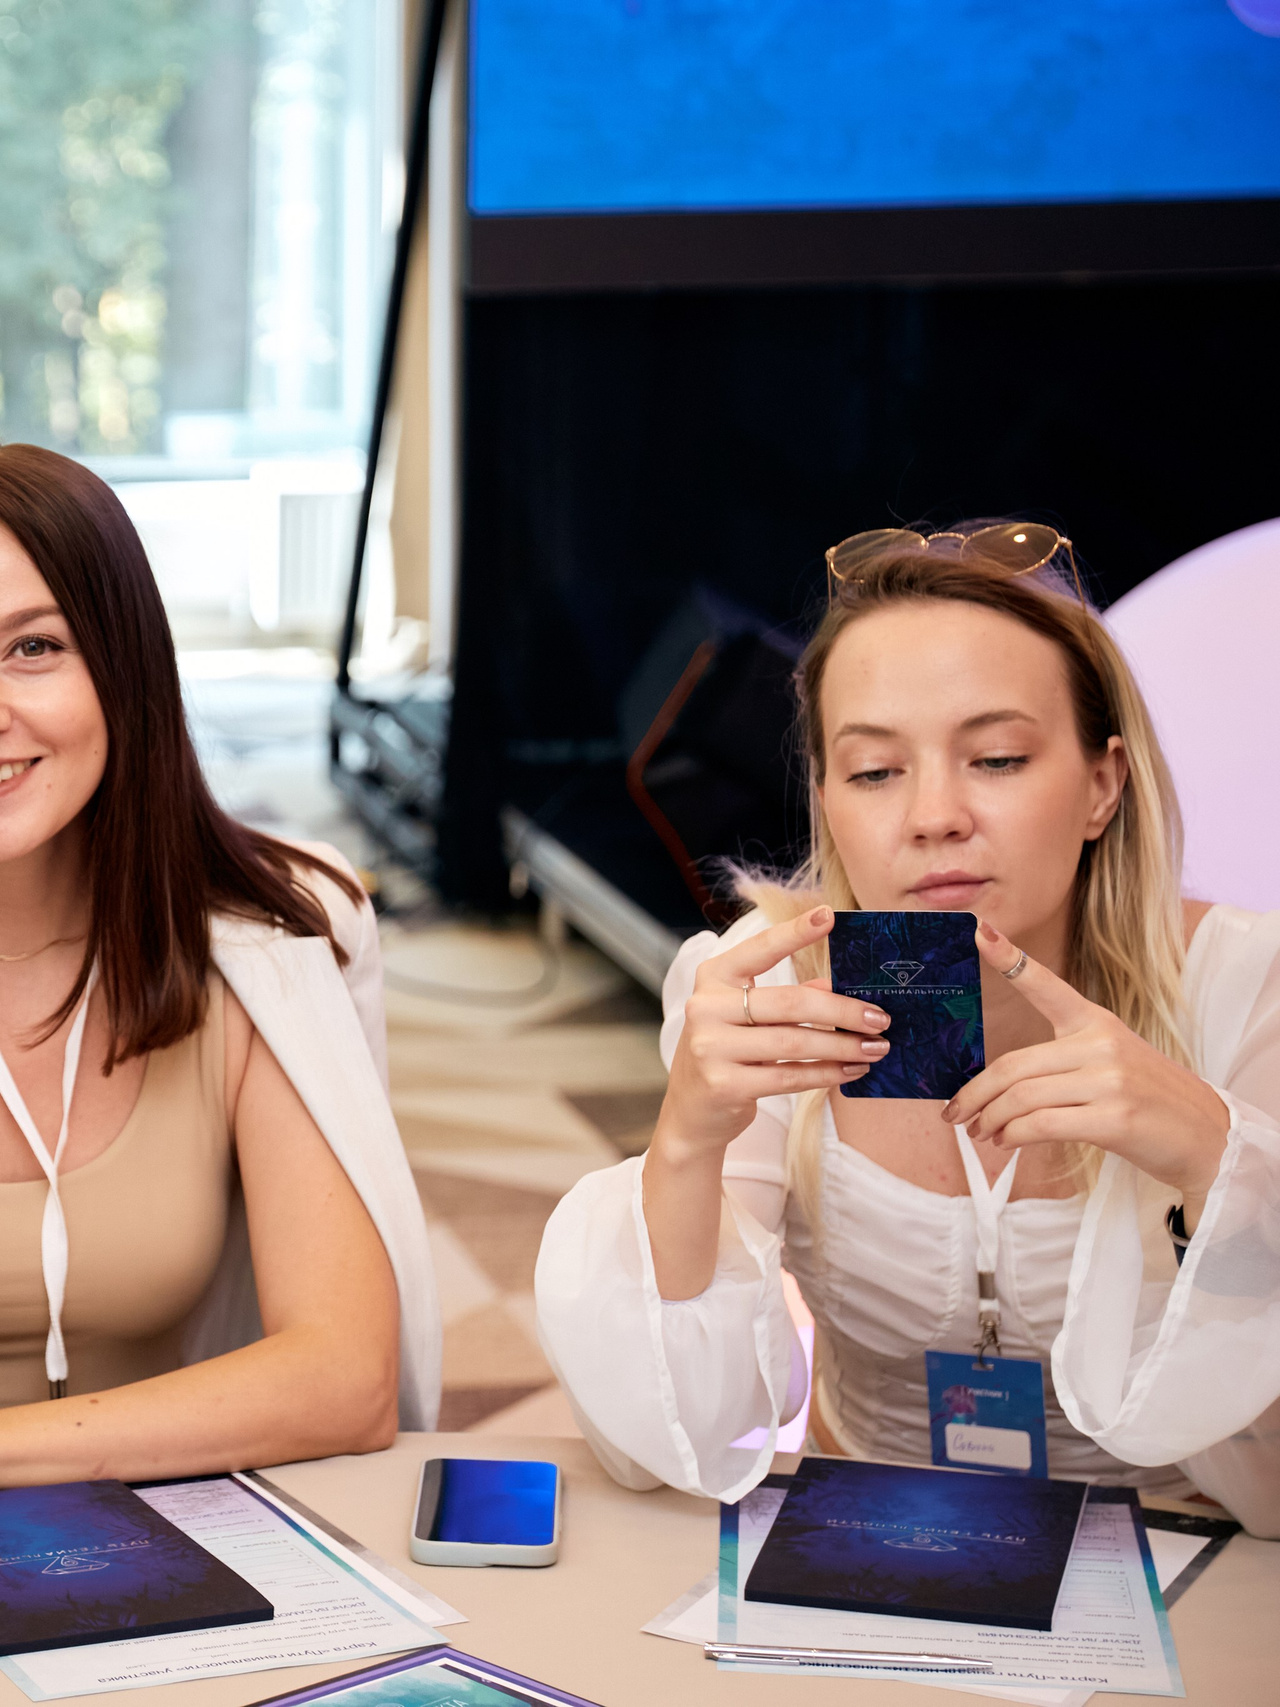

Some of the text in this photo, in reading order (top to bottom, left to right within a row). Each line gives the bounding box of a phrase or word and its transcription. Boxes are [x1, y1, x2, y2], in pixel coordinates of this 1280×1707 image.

[107, 1540, 150, 1548] ПУТЬ
[97, 1642, 377, 1683] Карта «Пути гениальности» участника
[1007, 1672, 1056, 1680] «Пути
